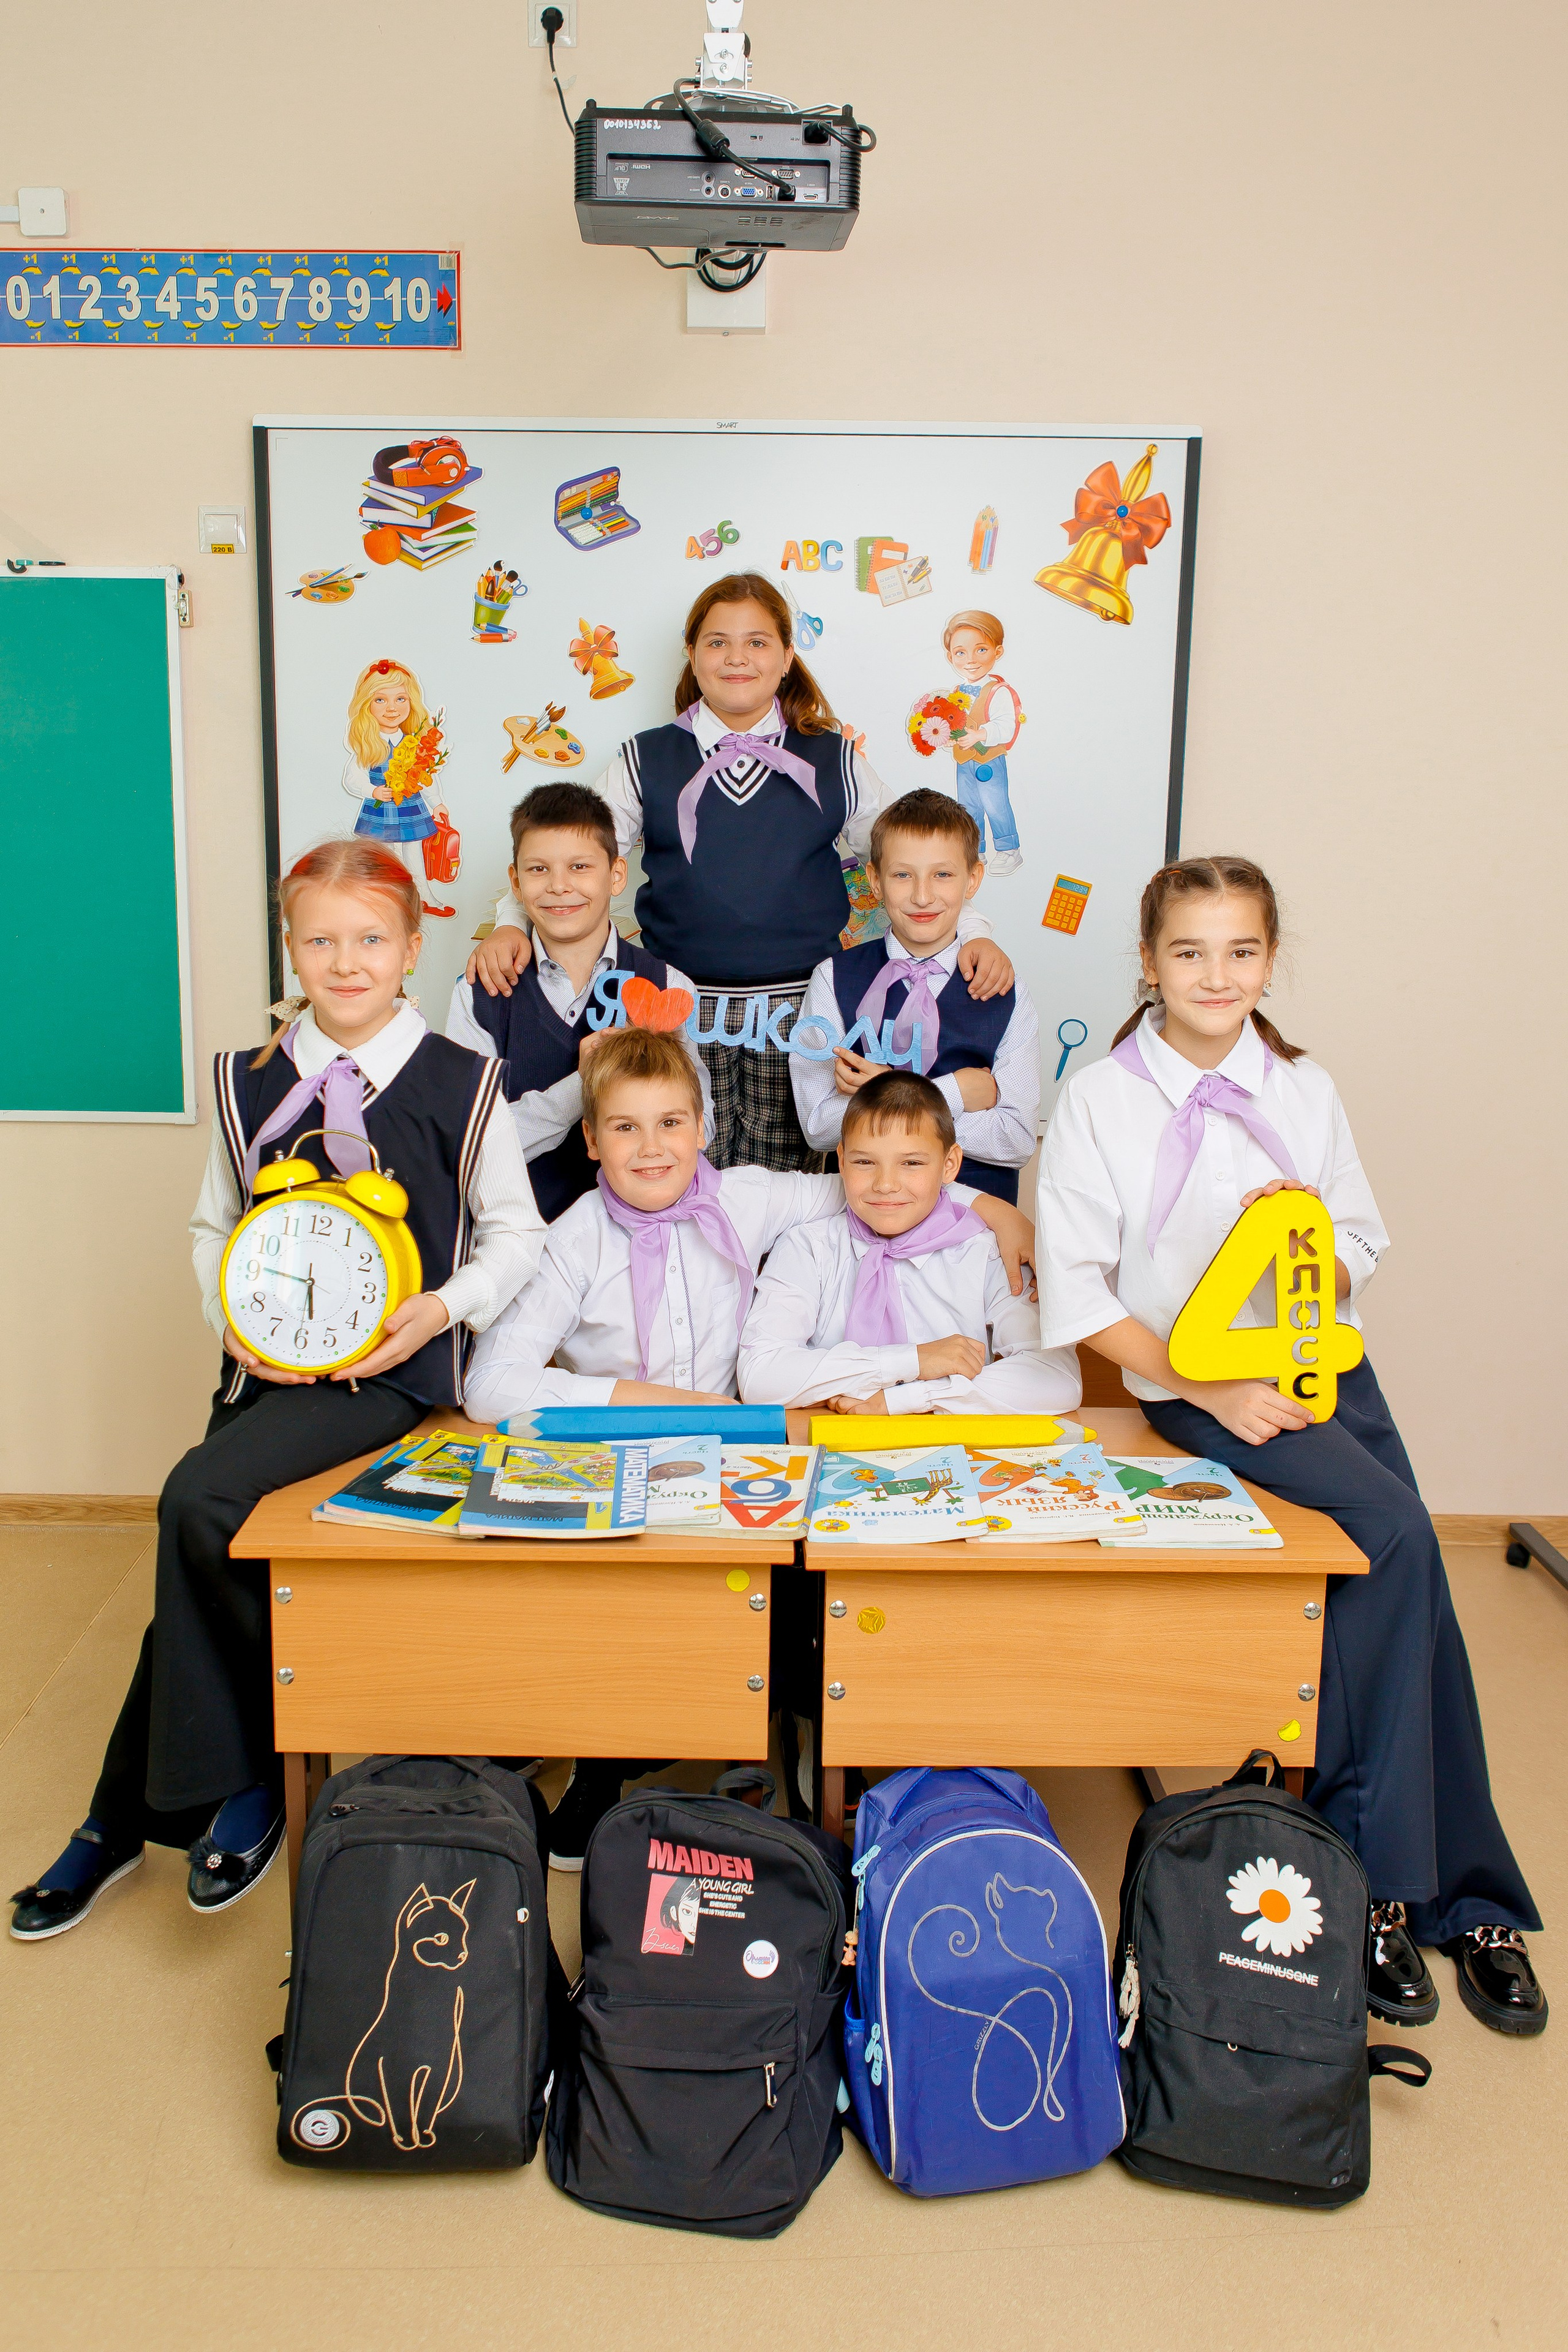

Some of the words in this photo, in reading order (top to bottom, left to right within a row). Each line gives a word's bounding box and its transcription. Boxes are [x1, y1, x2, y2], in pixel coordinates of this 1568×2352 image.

[23, 253, 38, 265] +1
[61, 253, 77, 265] +1
[101, 253, 117, 265] +1
[141, 253, 156, 265] +1
[179, 254, 195, 265] +1
[217, 254, 233, 266] +1
[257, 254, 273, 266] +1
[294, 254, 309, 266] +1
[333, 255, 349, 266] +1
[374, 255, 389, 266] +1
[6, 274, 31, 320] 0
[42, 274, 61, 320] 1
[78, 275, 104, 320] 2
[116, 275, 142, 321] 3
[155, 276, 181, 321] 4
[195, 276, 220, 322] 5
[233, 276, 258, 322] 6
[270, 277, 295, 322] 7
[307, 276, 333, 322] 8
[346, 276, 371, 323] 9
[383, 276, 431, 323] 10
[30, 331, 42, 342] -1
[68, 330, 80, 341] -1
[108, 331, 119, 342] -1
[147, 331, 159, 342] -1
[186, 331, 198, 342] -1
[223, 331, 235, 343] -1
[263, 333, 274, 343] -1
[299, 333, 311, 344] -1
[338, 333, 350, 344] -1
[379, 333, 390, 344] -1
[685, 519, 740, 559] 456
[780, 539, 843, 571] ABC
[281, 1216, 301, 1238] 11
[308, 1214, 333, 1237] 12
[257, 1234, 281, 1256] 10
[342, 1227, 353, 1247] 1
[1361, 1242, 1377, 1258] THE
[245, 1259, 262, 1281] 9
[358, 1251, 372, 1272] 2
[250, 1291, 266, 1313] 8
[361, 1281, 376, 1304] 3
[1167, 1189, 1365, 1424] 4
[268, 1316, 283, 1337] 7
[345, 1310, 360, 1330] 4
[294, 1328, 308, 1349] 6
[322, 1327, 337, 1348] 5
[619, 1447, 648, 1524] МАТЕМАТИКА
[355, 1497, 424, 1513] МАТЕМАТИКА
[826, 1506, 965, 1518] Математика
[1025, 1500, 1123, 1514] Русский
[486, 1513, 564, 1523] МАТЕМАТИКА
[647, 1838, 754, 1881] MAIDEN
[696, 1877, 732, 1893] YOUNG
[731, 1882, 755, 1894] GIRL
[725, 1910, 745, 1919] CENTER
[974, 2020, 989, 2050] GRIZZLY
